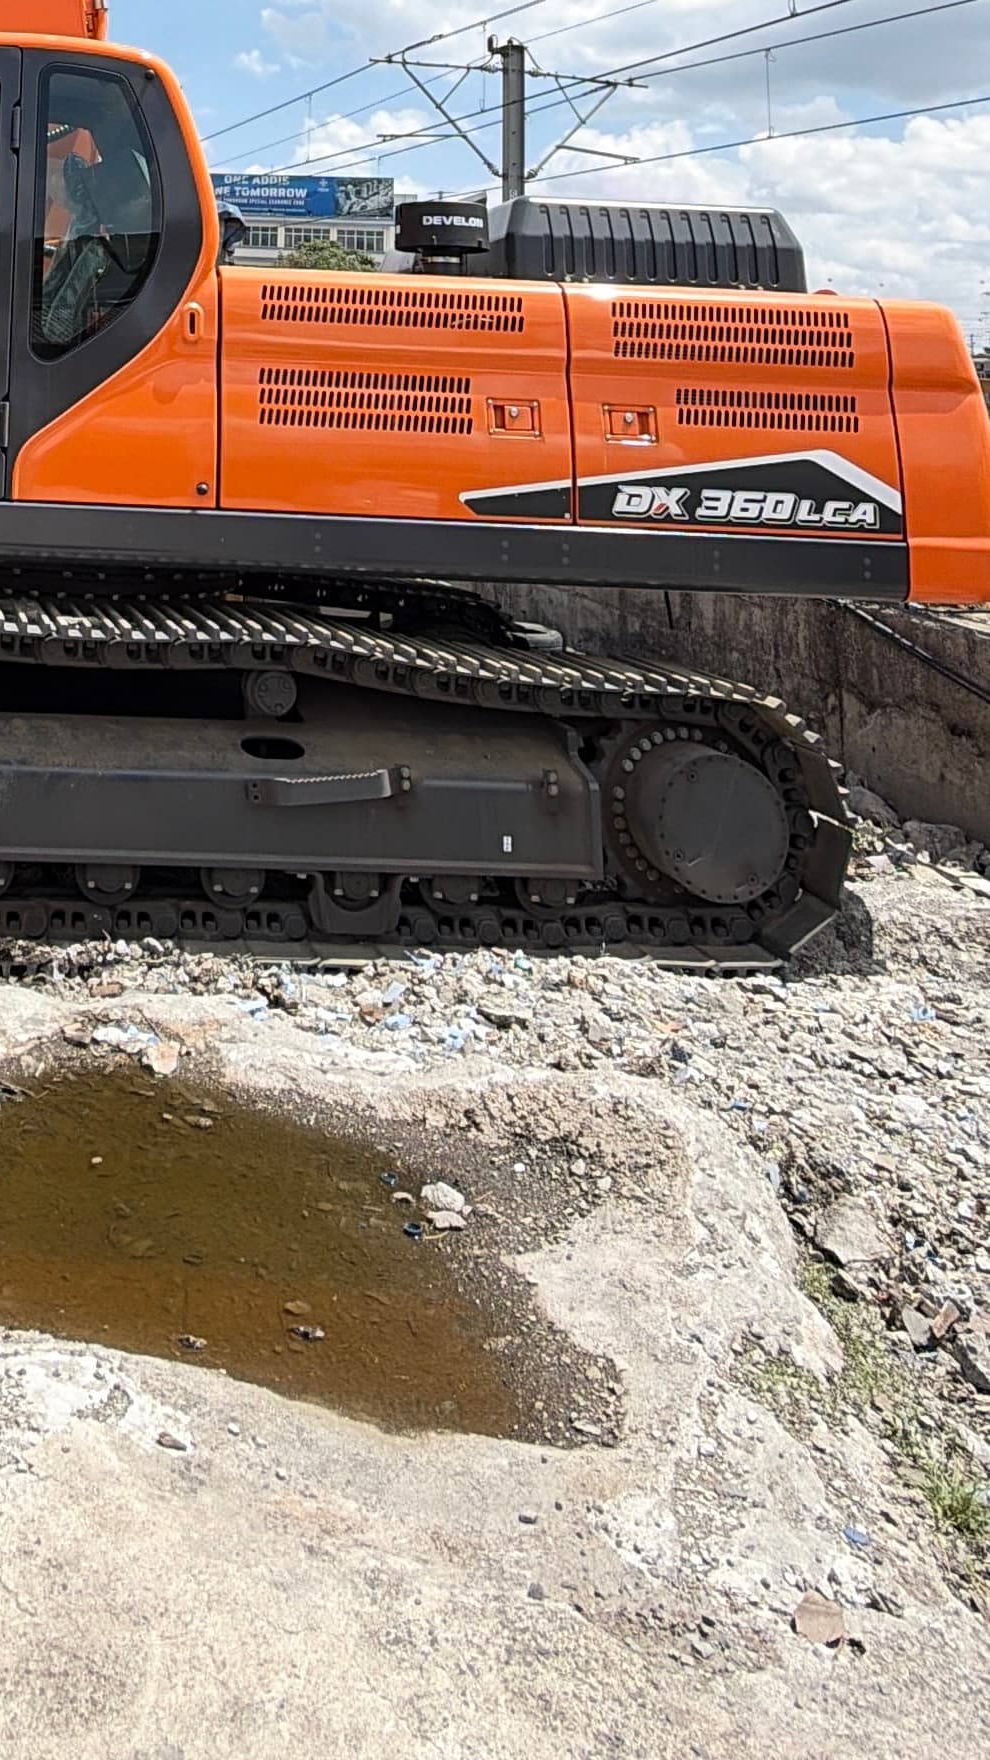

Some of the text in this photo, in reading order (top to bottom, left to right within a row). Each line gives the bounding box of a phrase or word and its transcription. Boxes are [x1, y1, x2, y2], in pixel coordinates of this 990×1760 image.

[224, 175, 290, 186] ONE ADDIS
[233, 186, 308, 198] TOMORROW
[422, 215, 484, 228] DEVELON
[613, 484, 690, 521] DX
